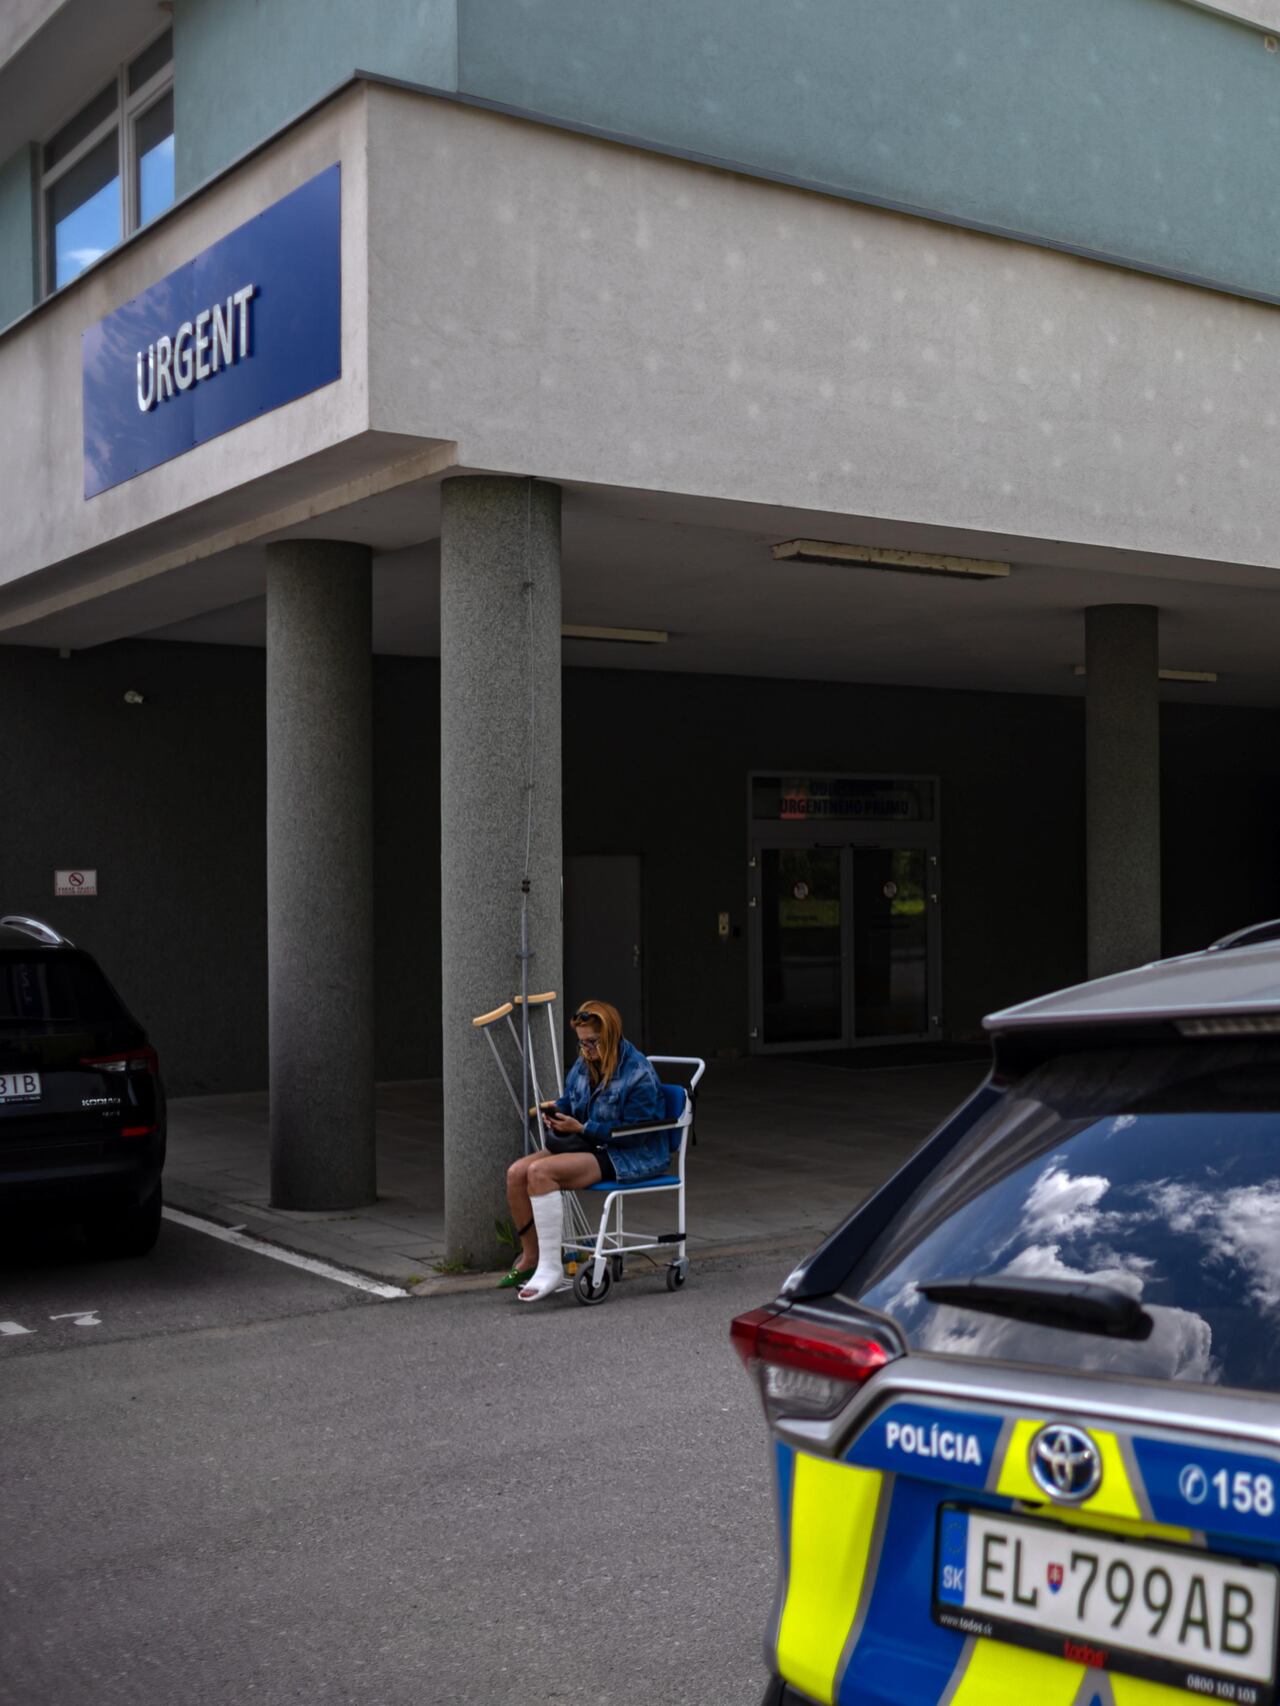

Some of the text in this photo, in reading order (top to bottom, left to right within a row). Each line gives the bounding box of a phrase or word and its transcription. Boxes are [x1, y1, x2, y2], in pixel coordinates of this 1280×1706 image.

[136, 284, 256, 412] URGENT
[885, 1421, 981, 1465] POLÍCIA
[1213, 1469, 1274, 1517] 158
[942, 1565, 963, 1593] SK
[1186, 1673, 1214, 1692] 0800
